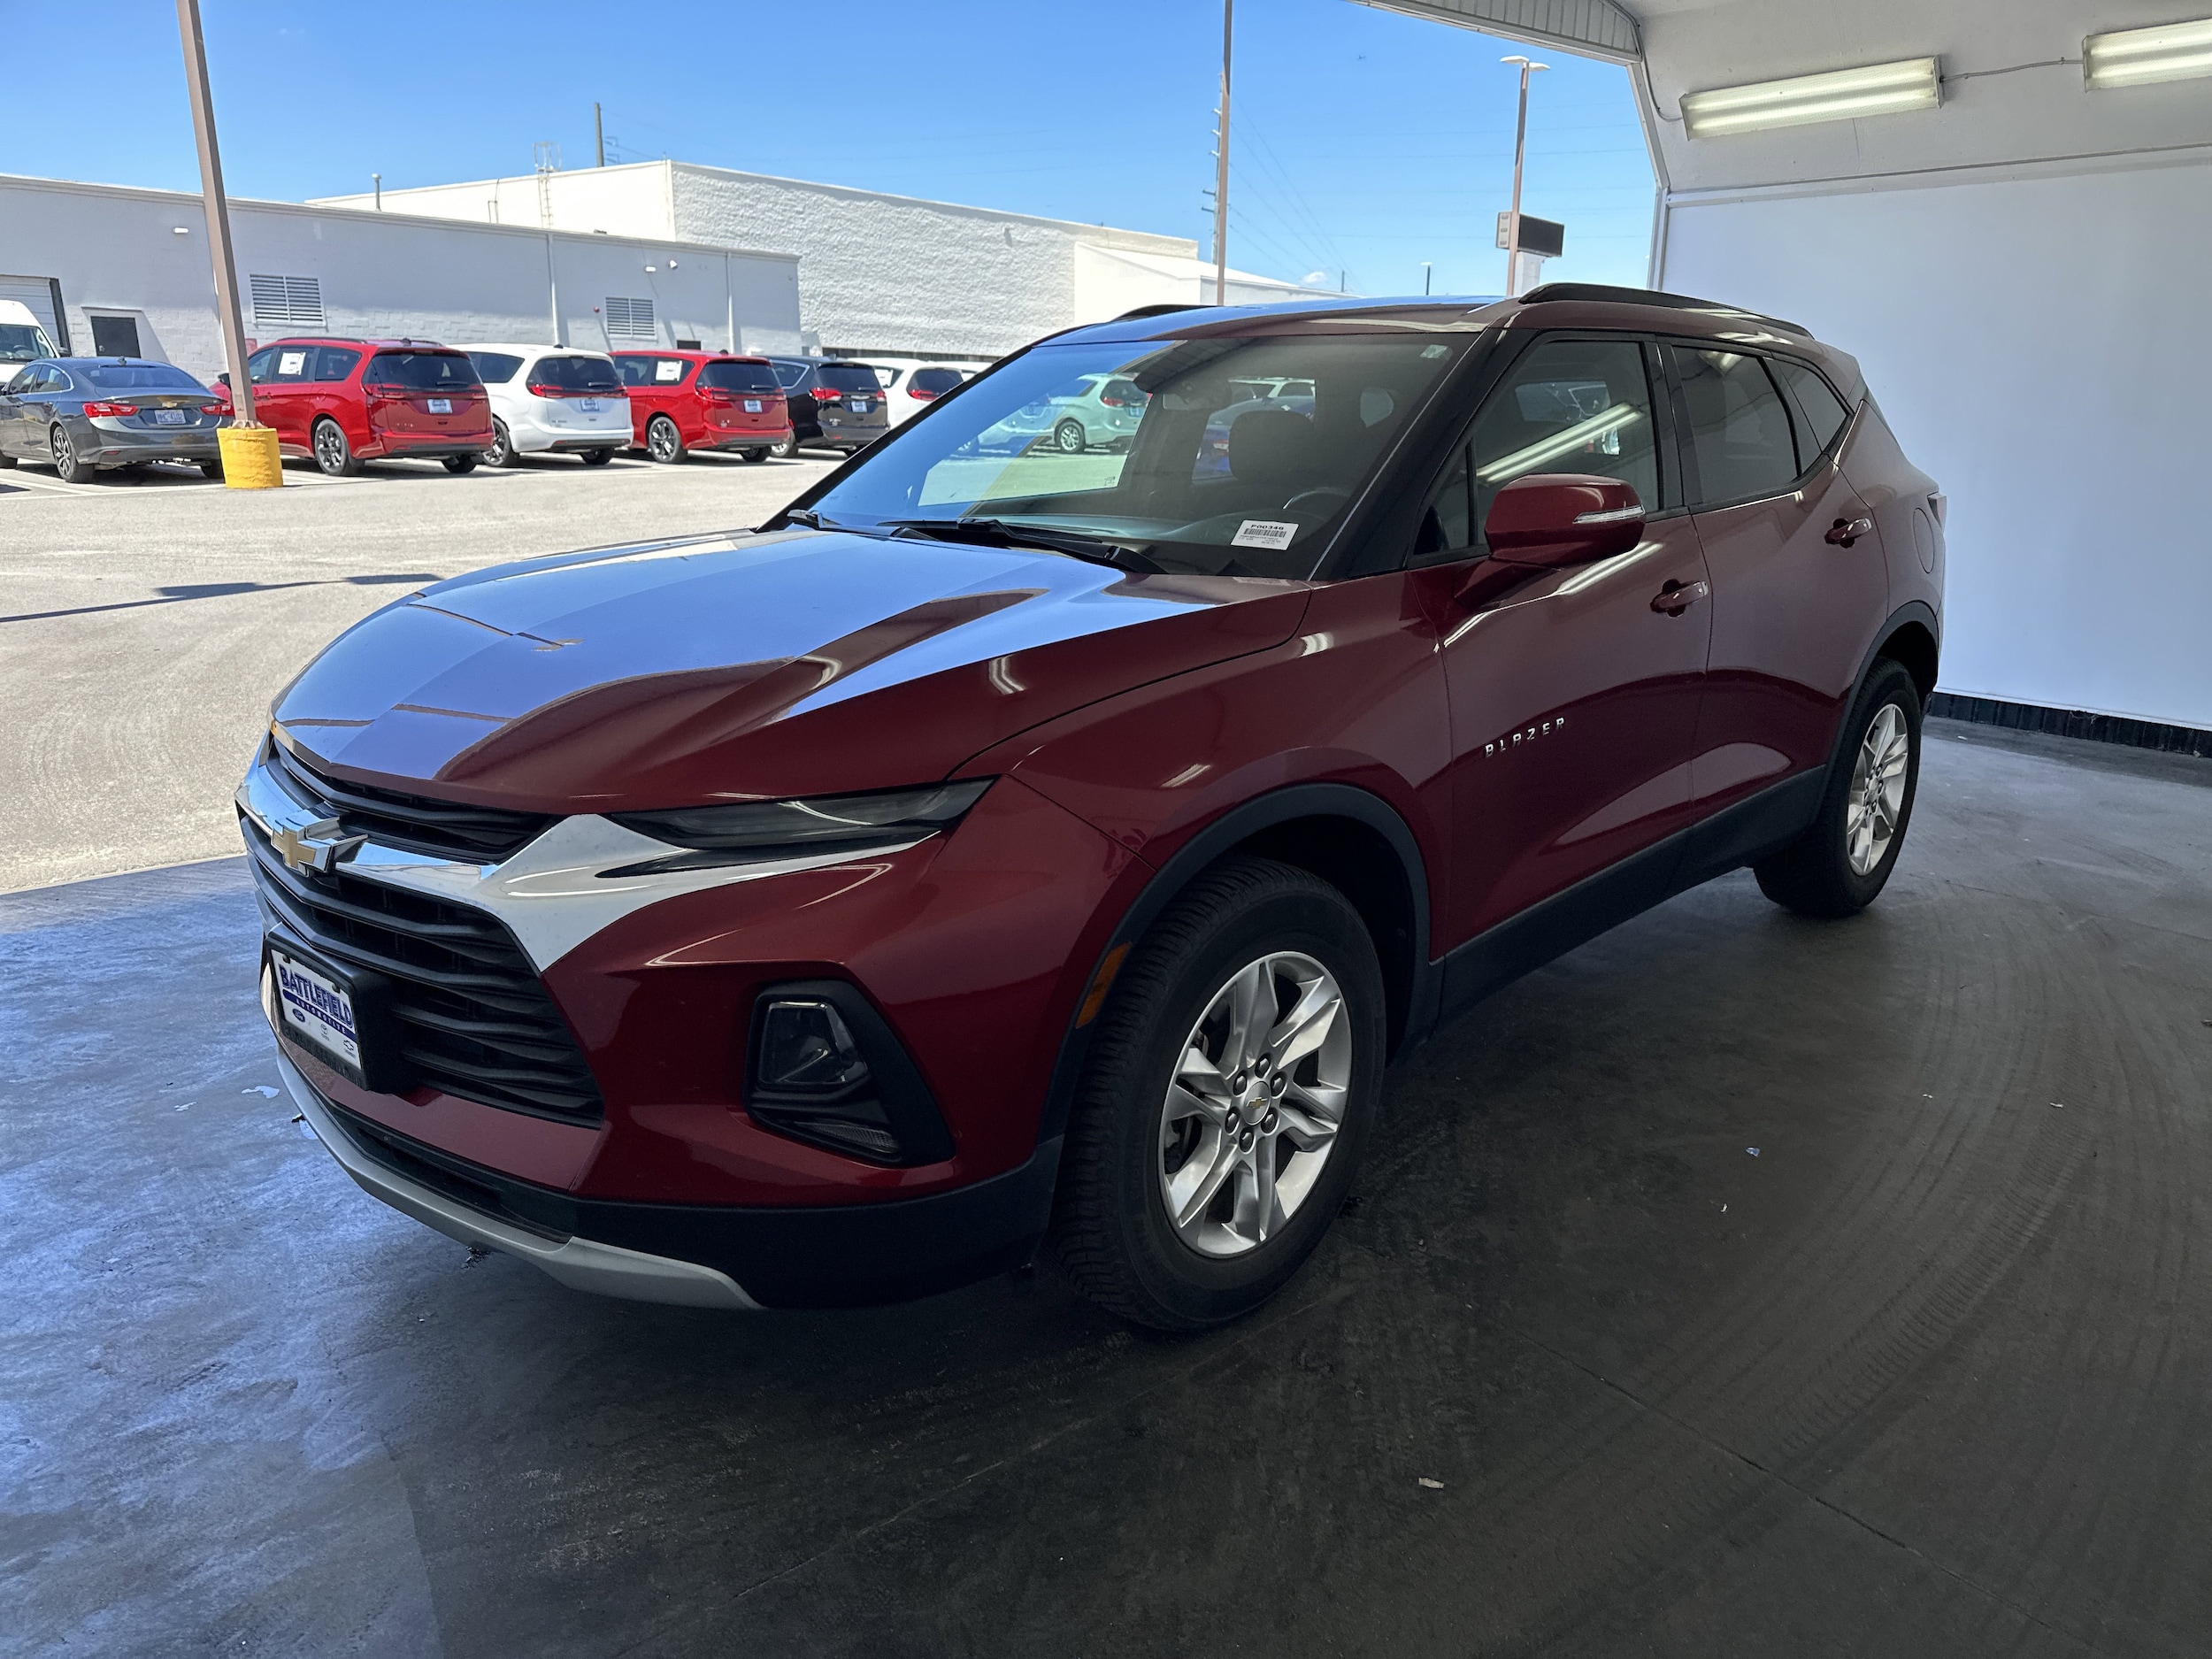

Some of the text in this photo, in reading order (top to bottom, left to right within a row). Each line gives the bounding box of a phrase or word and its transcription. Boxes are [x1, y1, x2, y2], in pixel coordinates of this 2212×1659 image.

[1485, 717, 1564, 758] BLAZER
[278, 964, 353, 1029] BATTLEFIELD
[295, 997, 347, 1034] AUTOMOTIVE
